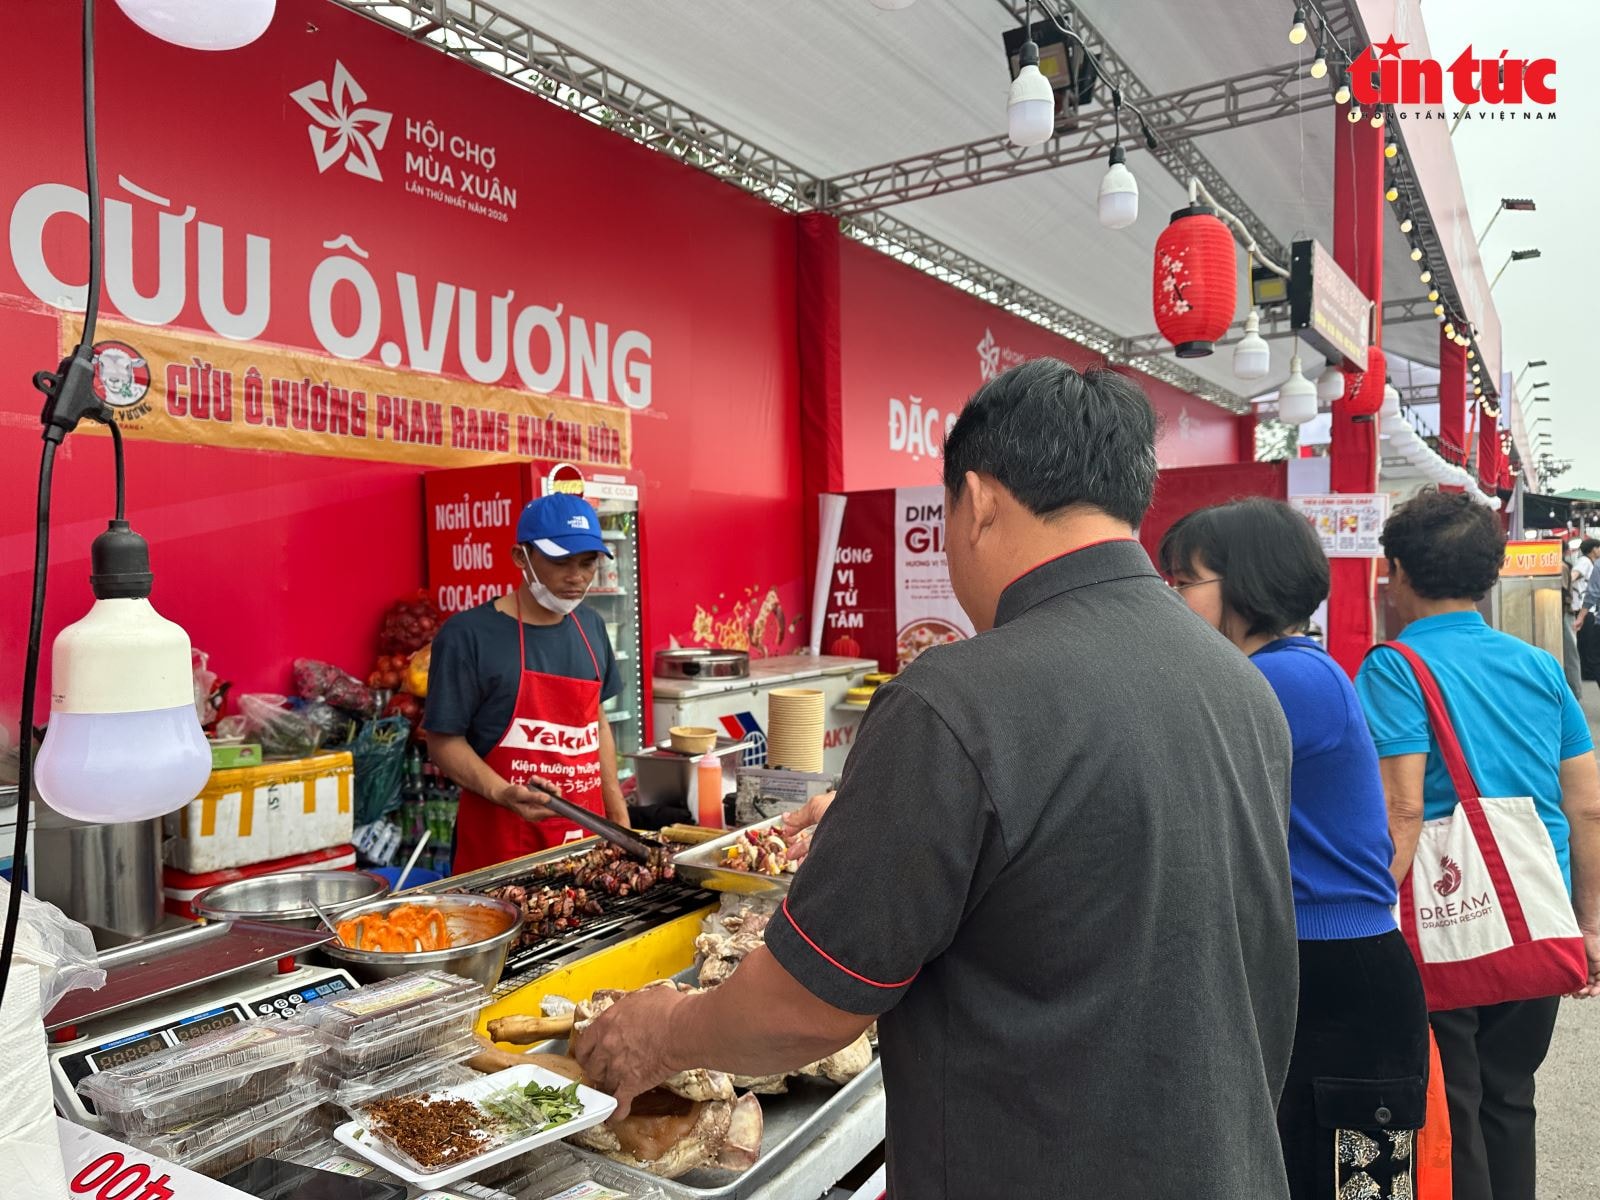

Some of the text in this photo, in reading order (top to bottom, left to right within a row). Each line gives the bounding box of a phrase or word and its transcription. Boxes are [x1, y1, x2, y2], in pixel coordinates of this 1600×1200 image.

[405, 117, 496, 173] HỘI CHỢ
[405, 151, 517, 209] MÙA XUÂN
[10, 174, 653, 409] CỪU Ô.VƯƠNG
[166, 357, 621, 464] CỪU Ô.VƯƠNG PHAN RANG KHÁNH HÒA
[888, 394, 940, 462] ĐẶC
[435, 492, 512, 531] NGHỈ CHÚT
[905, 504, 945, 522] DIM
[452, 532, 493, 571] UỐNG
[904, 526, 946, 554] GI
[835, 546, 873, 564] ƯƠNG
[837, 569, 854, 587] VỊ
[828, 610, 864, 628] TÂM
[823, 725, 853, 750] AKY
[511, 759, 537, 773] Kiện
[1420, 892, 1491, 920] DREAM
[1422, 906, 1493, 929] DRAGON RESORT
[261, 1004, 269, 1012] 7
[291, 995, 301, 1003] 9
[284, 1008, 293, 1016] 5
